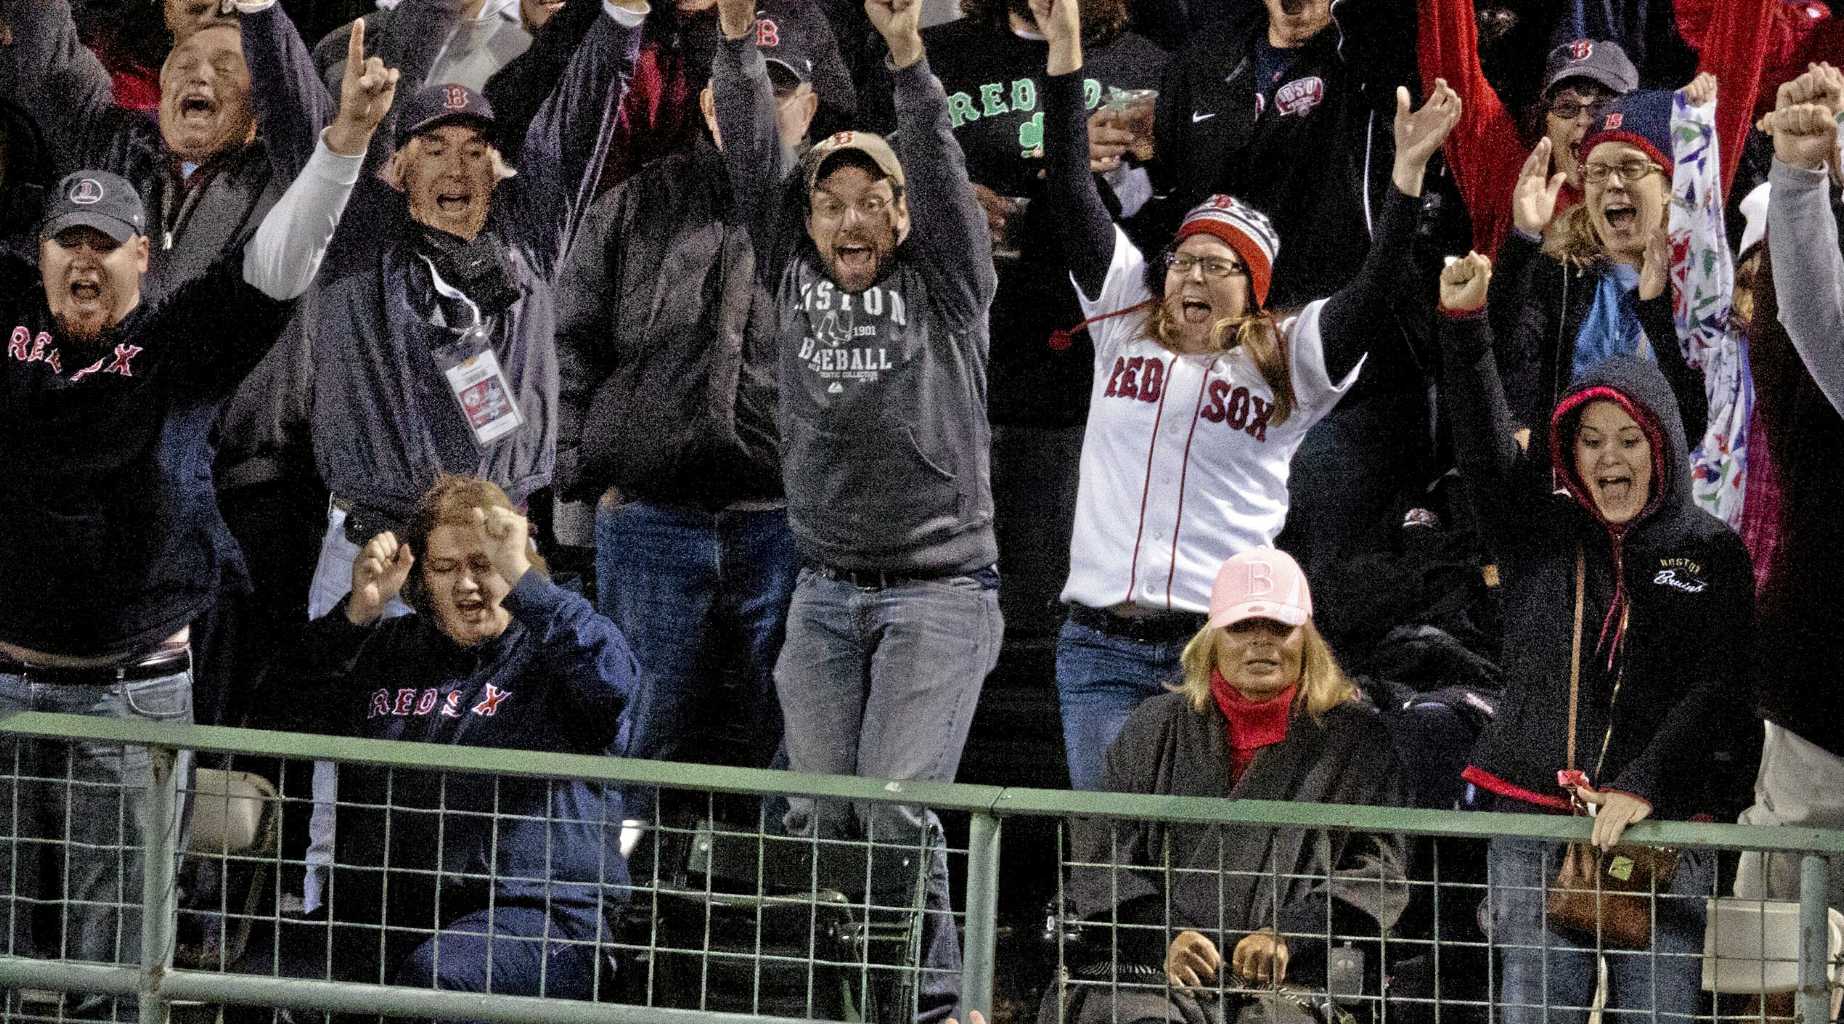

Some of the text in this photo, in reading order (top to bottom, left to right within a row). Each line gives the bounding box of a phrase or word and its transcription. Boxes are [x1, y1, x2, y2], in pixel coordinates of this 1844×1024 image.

[755, 19, 780, 47] B
[1569, 39, 1593, 63] B
[442, 83, 470, 110] B
[947, 78, 1037, 128] RED
[1603, 112, 1624, 130] B
[853, 325, 877, 337] 1901
[798, 337, 893, 372] BAEBALL
[1103, 355, 1276, 443] RED SOX
[1245, 560, 1273, 597] B
[367, 682, 513, 719] RED SX
